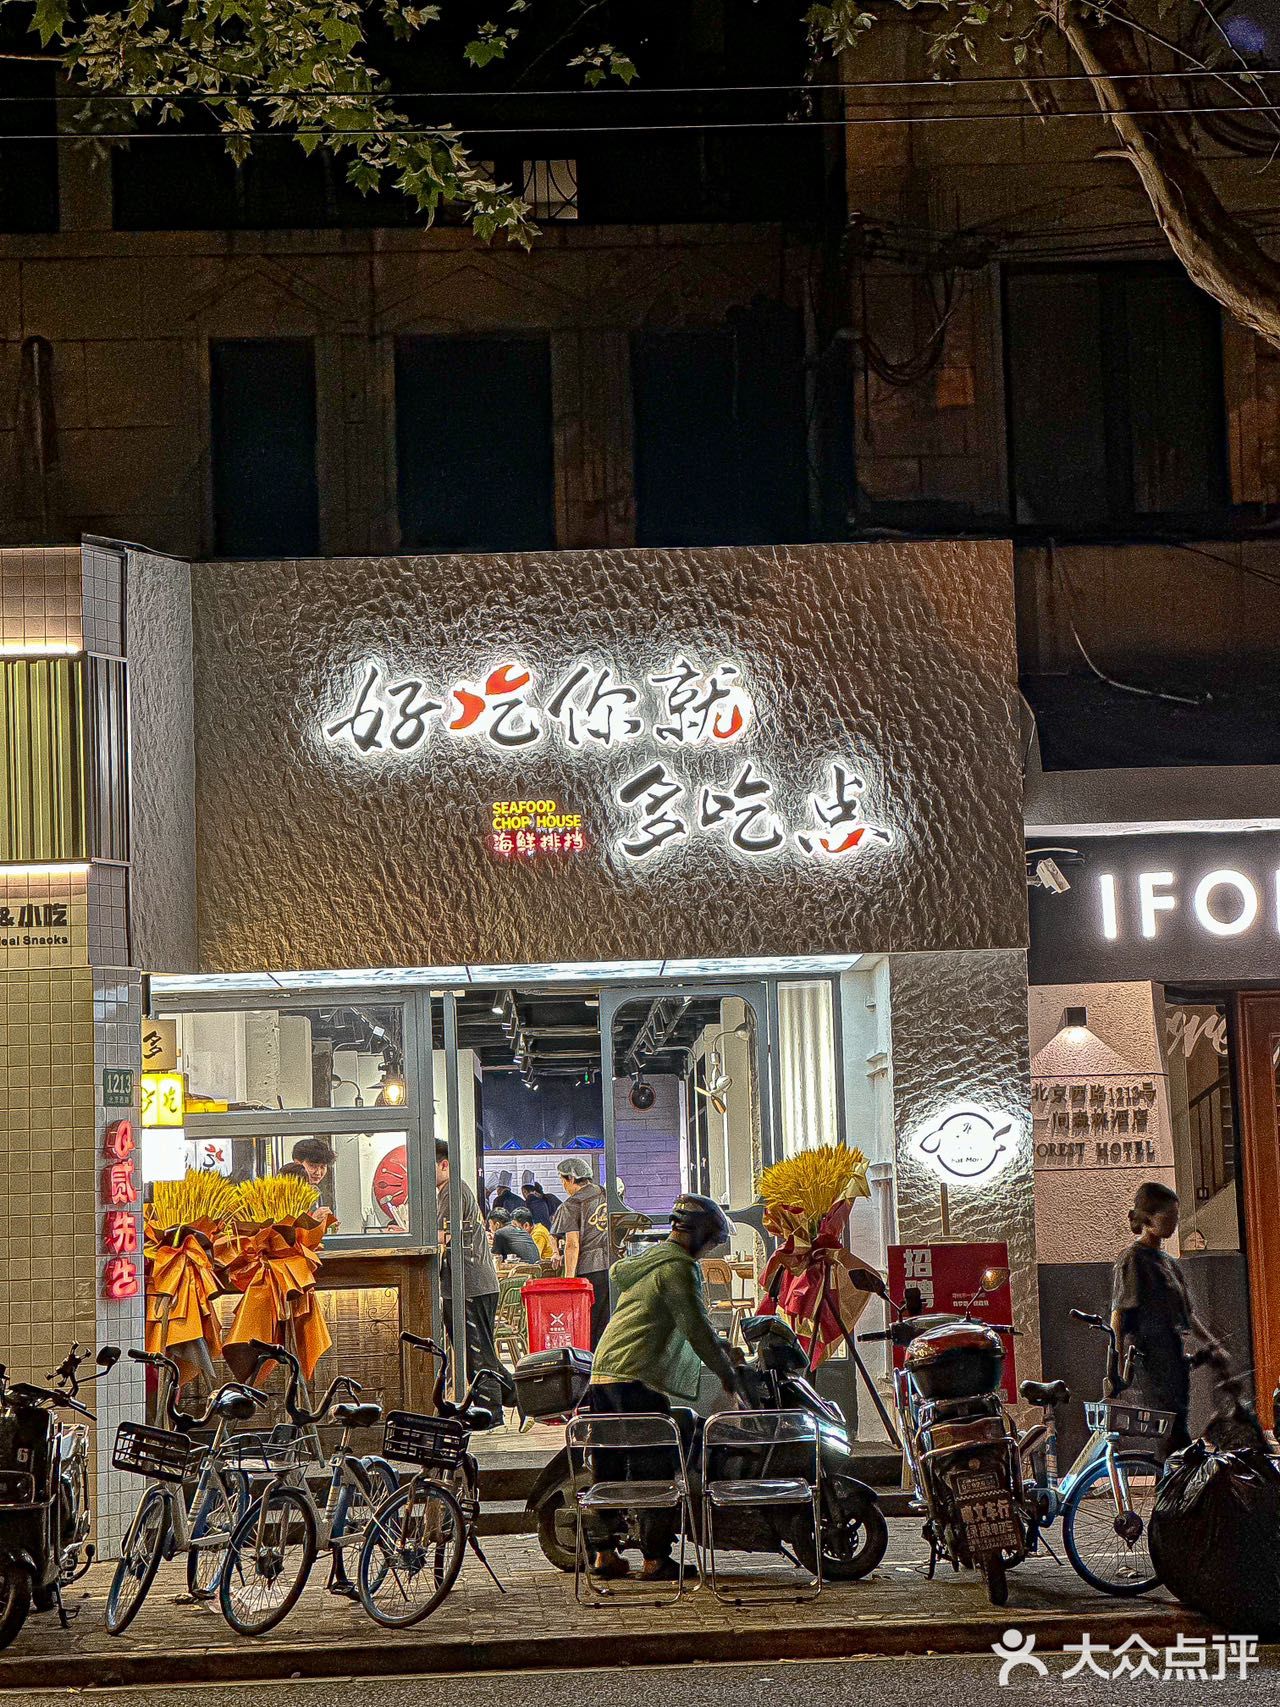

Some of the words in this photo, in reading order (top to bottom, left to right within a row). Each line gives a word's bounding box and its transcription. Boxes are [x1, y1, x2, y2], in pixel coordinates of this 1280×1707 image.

[326, 656, 743, 753] 好吃你就
[492, 800, 556, 814] SEAFOOD
[618, 763, 892, 857] 多吃点
[492, 816, 531, 830] CHOP
[536, 814, 581, 828] HOUSE
[1100, 869, 1280, 939] IFO
[23, 935, 68, 945] Snacks
[106, 1073, 131, 1094] 1213
[1034, 1142, 1085, 1160] OREST
